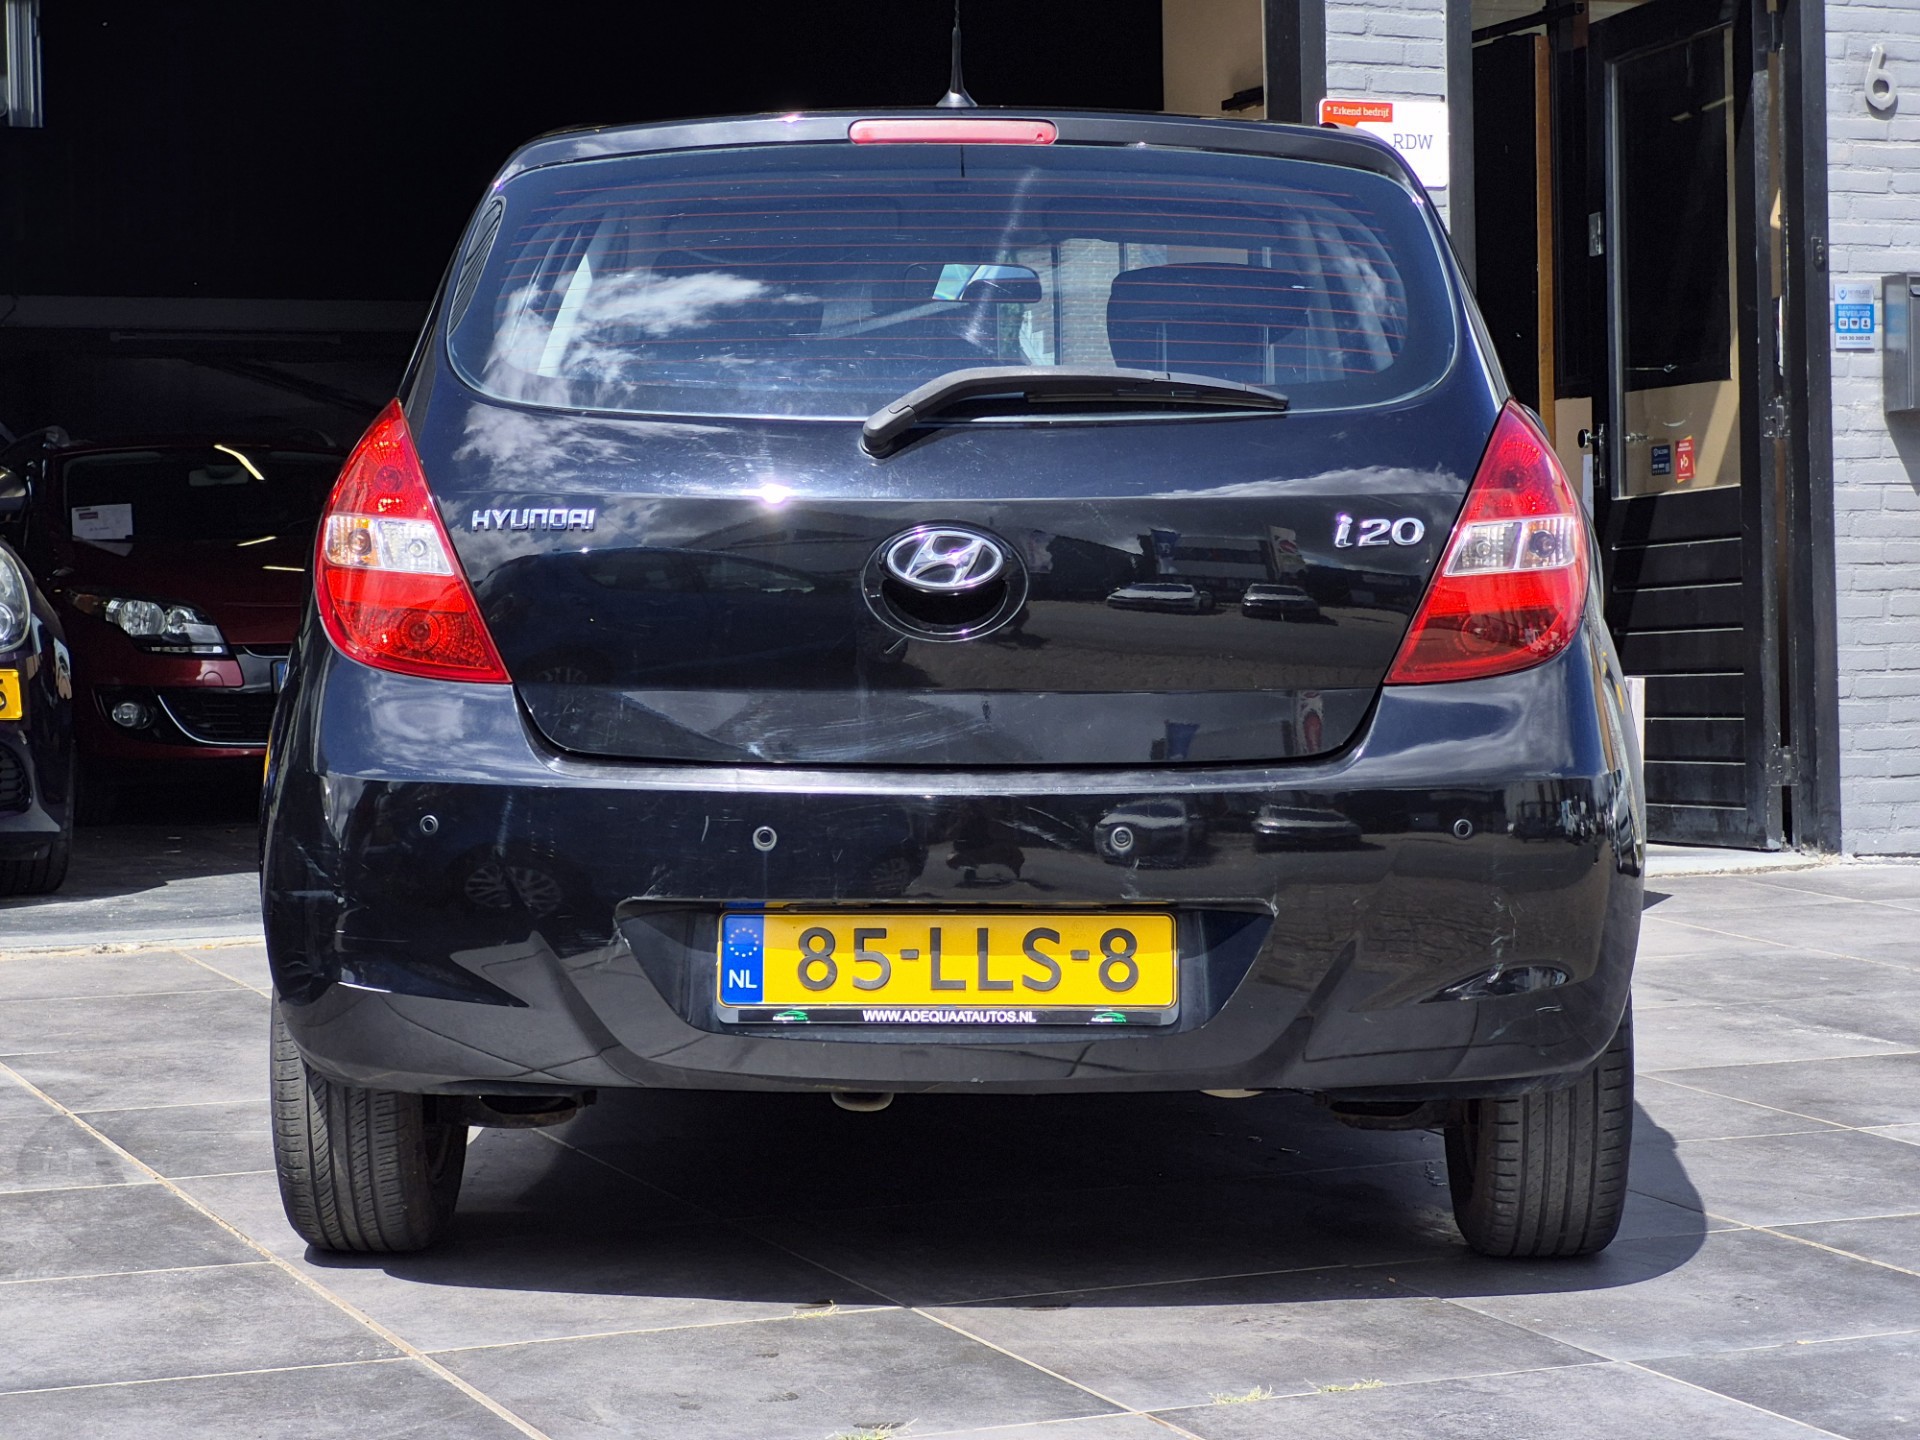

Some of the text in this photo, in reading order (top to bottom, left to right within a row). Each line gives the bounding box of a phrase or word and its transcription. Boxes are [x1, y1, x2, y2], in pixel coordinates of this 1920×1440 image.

[1865, 44, 1897, 111] 6
[1332, 106, 1390, 118] Erkend bedrijf
[1393, 133, 1433, 150] RDW
[471, 508, 596, 531] HYUNDAI
[796, 926, 1139, 993] 85-LLS-8
[728, 968, 758, 988] NL
[862, 1009, 1038, 1024] WWW.ADEQUAATAUTOS.NL
